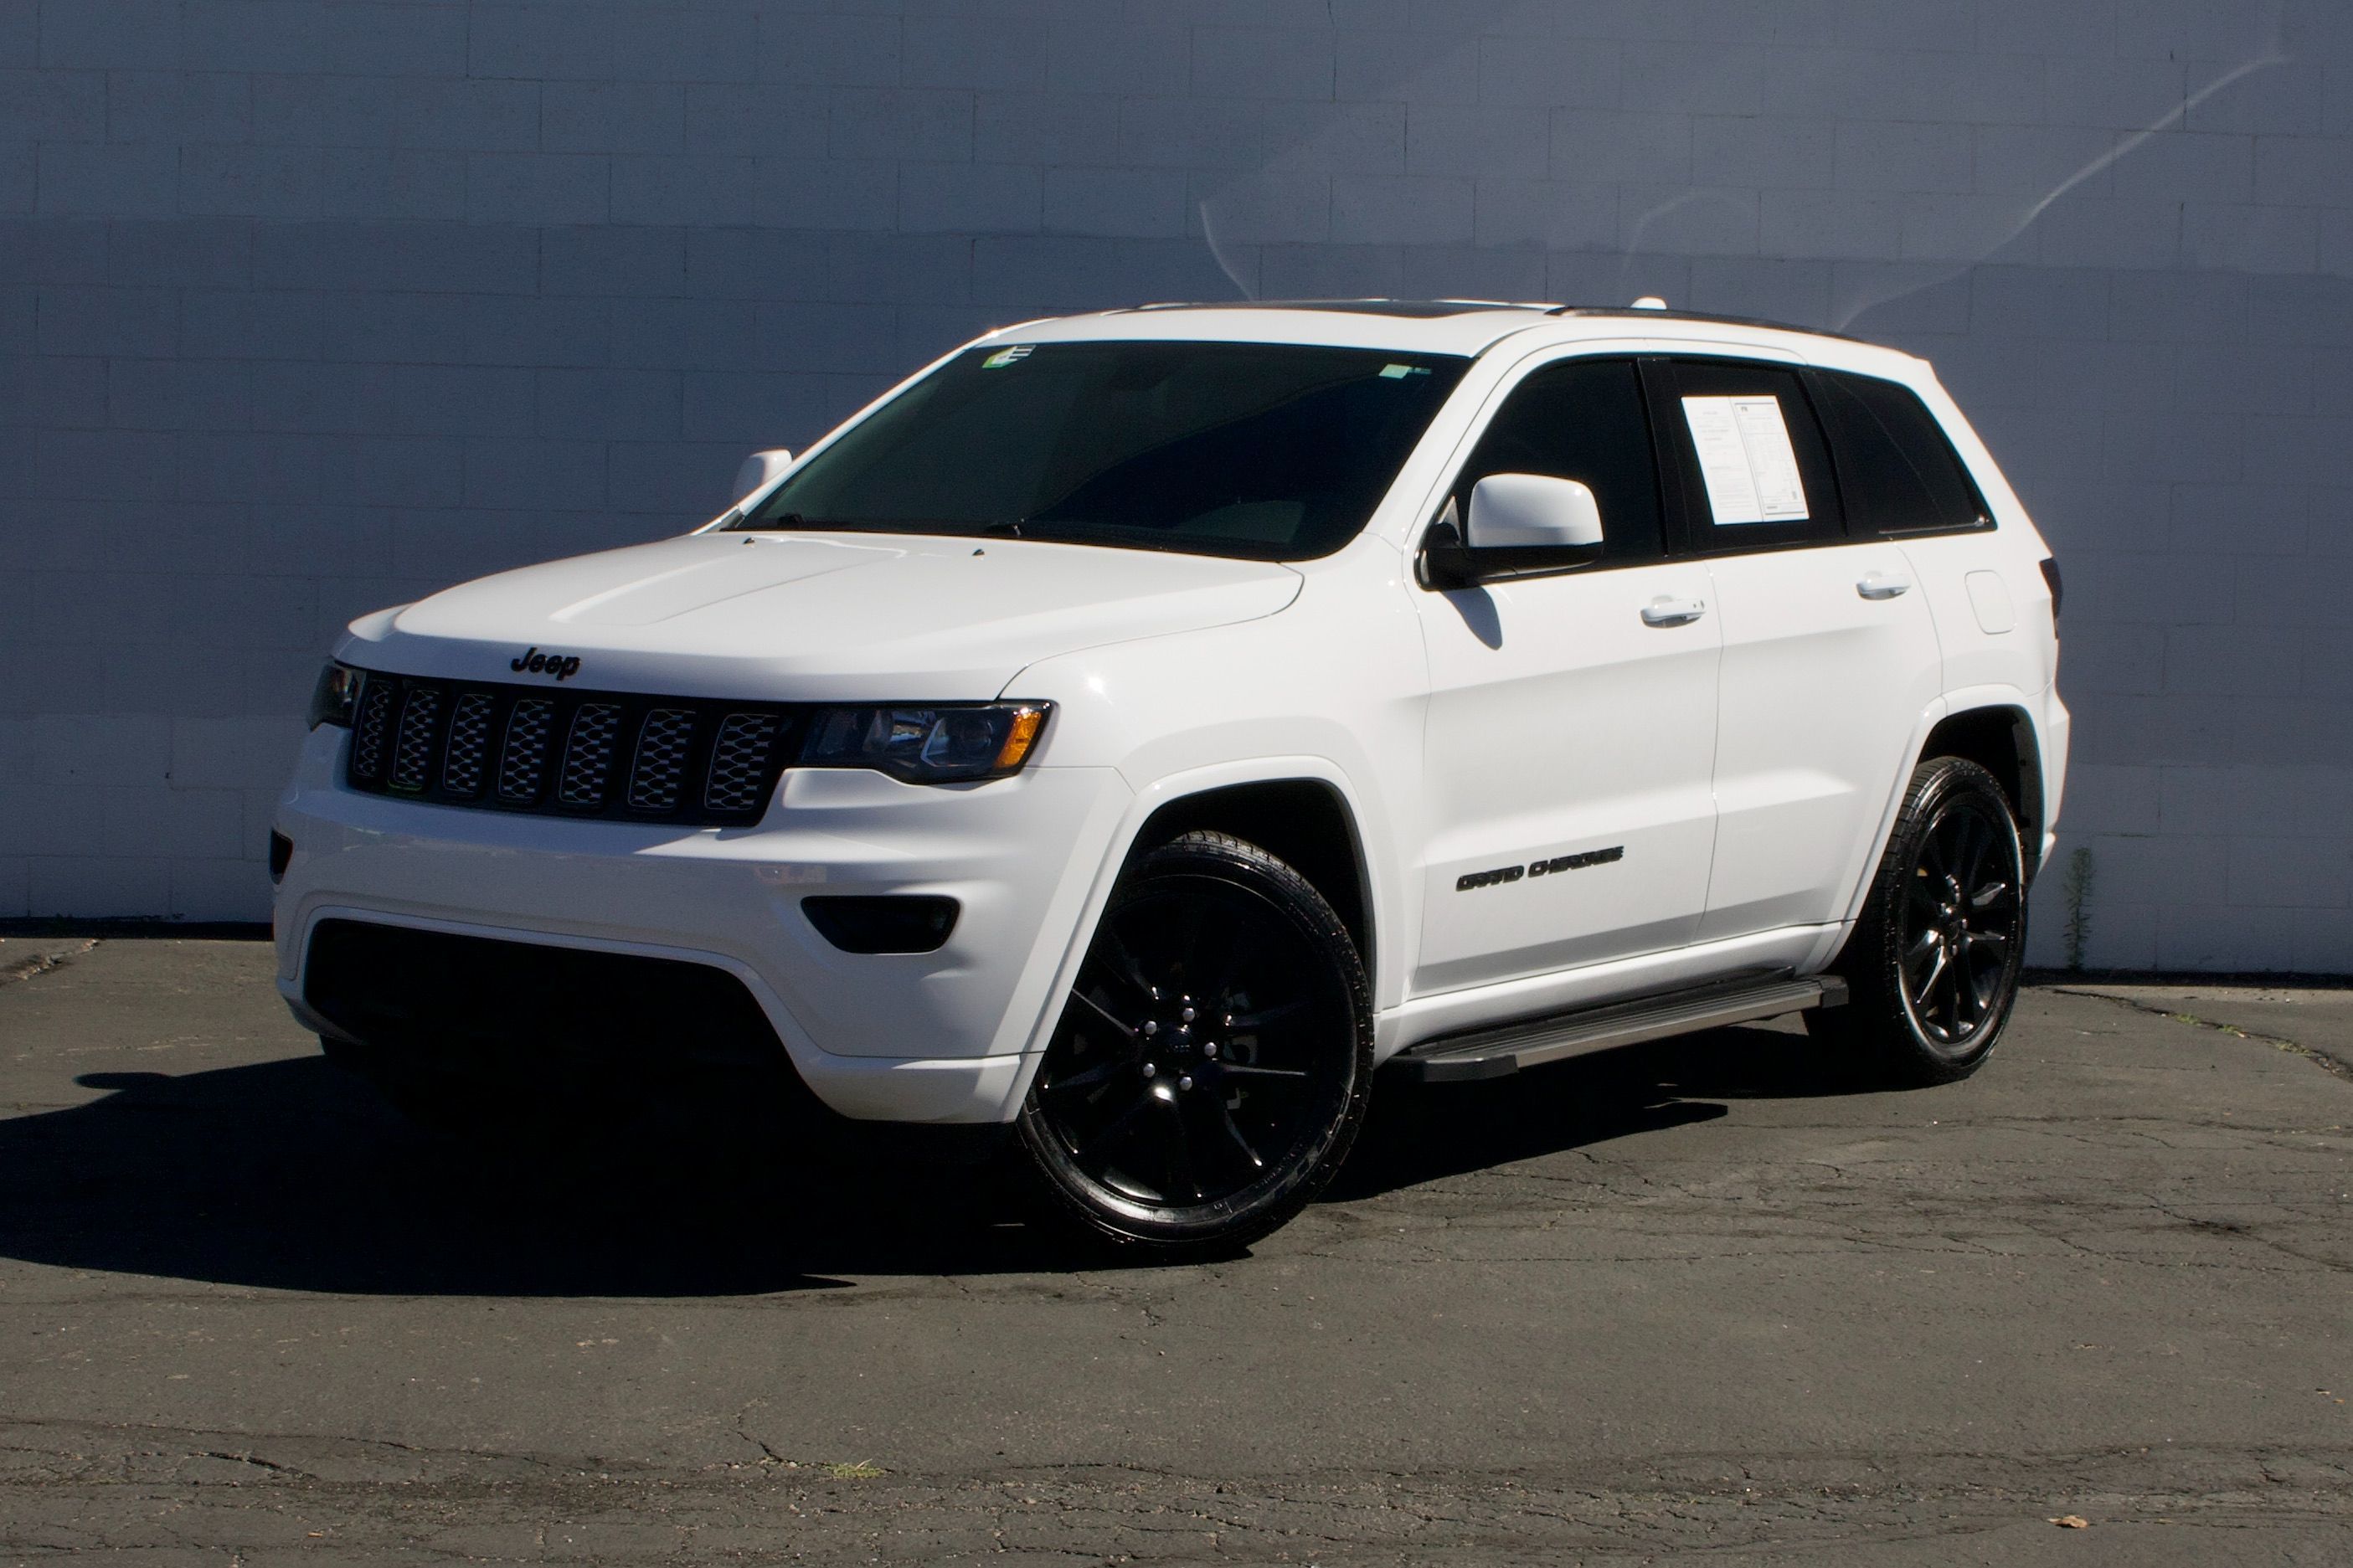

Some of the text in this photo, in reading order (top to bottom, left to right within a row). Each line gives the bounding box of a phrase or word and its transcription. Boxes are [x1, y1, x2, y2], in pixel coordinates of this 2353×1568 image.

[511, 647, 581, 681] Jeep
[1455, 846, 1624, 892] GRAND CHEROKEE
